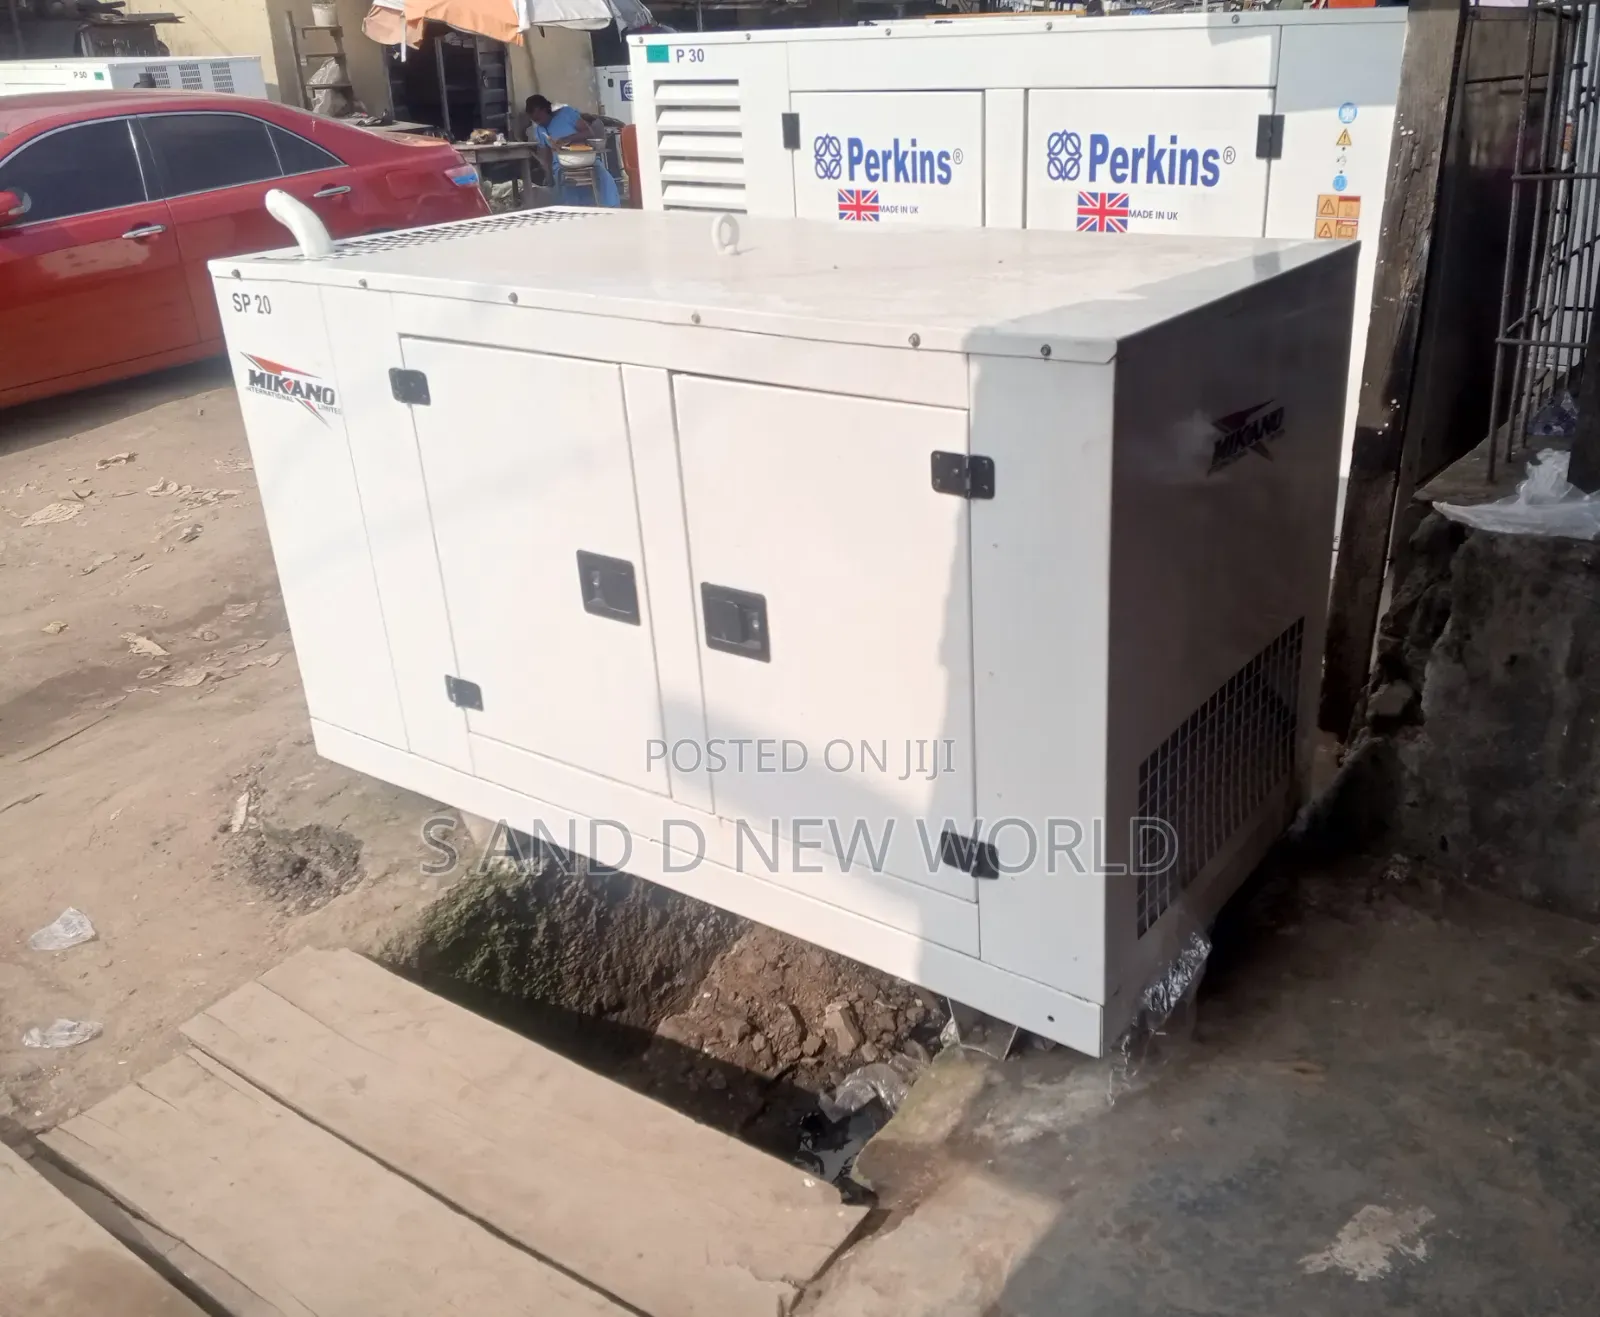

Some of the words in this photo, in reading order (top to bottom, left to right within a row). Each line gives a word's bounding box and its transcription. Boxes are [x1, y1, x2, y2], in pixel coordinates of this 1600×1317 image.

[676, 49, 685, 63] P
[688, 48, 705, 63] 30
[879, 204, 899, 214] MADE
[900, 205, 908, 214] IN
[909, 205, 919, 214] UK
[1128, 209, 1154, 219] MADE
[1155, 211, 1165, 220] IN
[1167, 211, 1179, 221] UK
[232, 293, 251, 313] SP
[255, 294, 272, 315] 20
[248, 368, 336, 406] MIKANO
